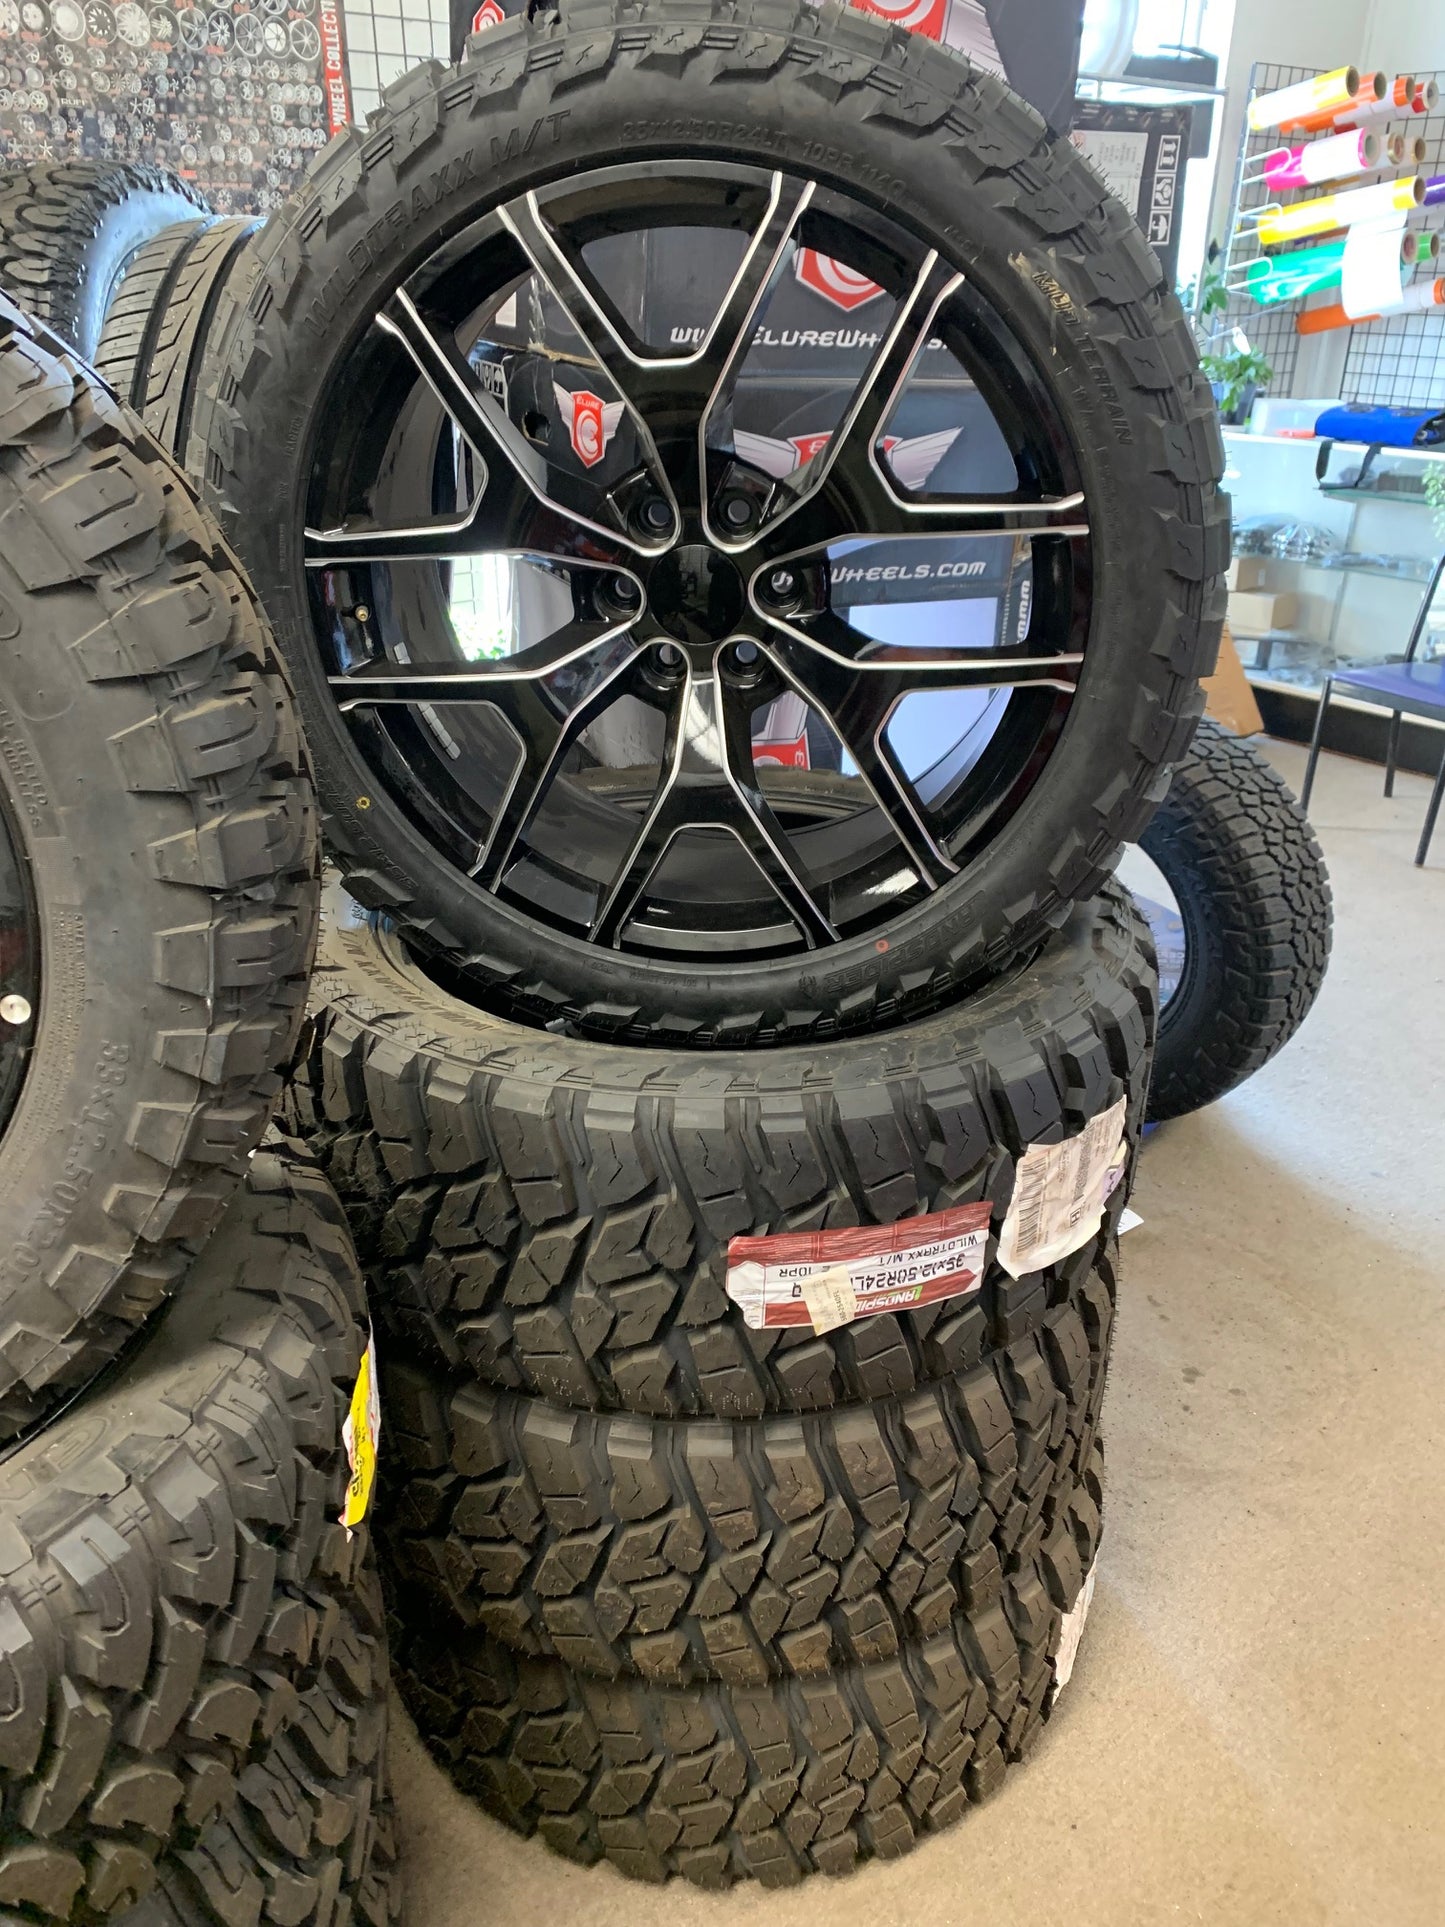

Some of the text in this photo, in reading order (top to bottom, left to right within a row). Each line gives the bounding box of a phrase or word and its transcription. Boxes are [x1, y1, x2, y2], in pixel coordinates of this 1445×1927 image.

[320, 0, 347, 126] WHEEL COLLECTI
[304, 110, 571, 341] WILDTRAXX M/T
[1031, 271, 1081, 326] MUD
[1073, 333, 1134, 443] TERRAIN
[830, 560, 987, 586] WHEELS.COM
[879, 1253, 904, 1267] M/T
[909, 1235, 977, 1260] WILDTRAXX
[855, 1287, 922, 1313] LANDSPID
